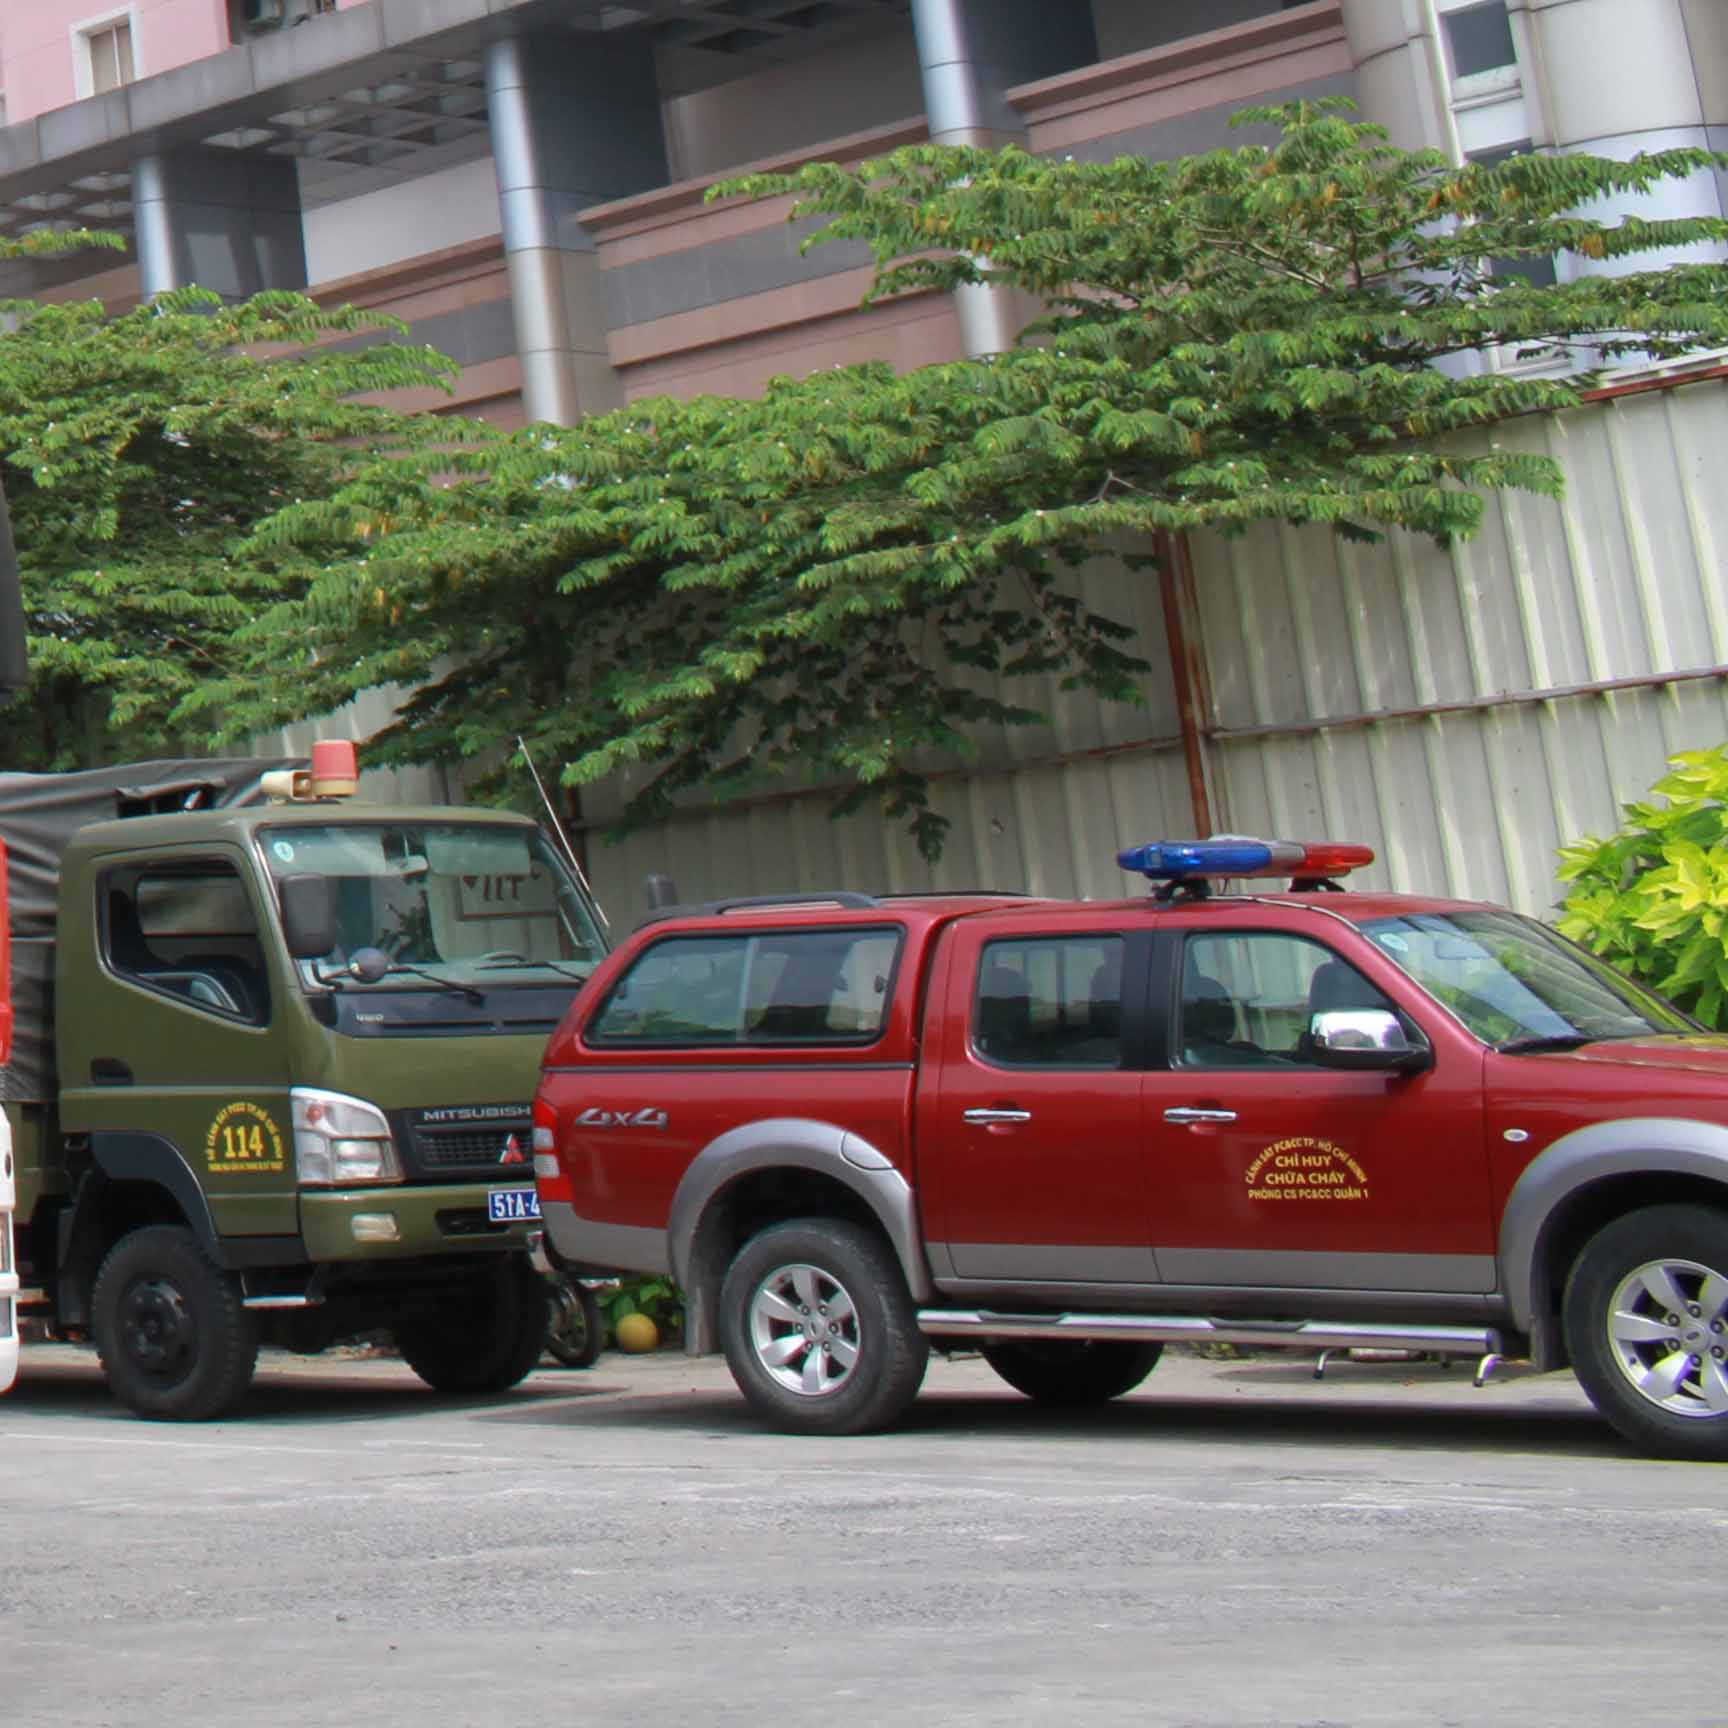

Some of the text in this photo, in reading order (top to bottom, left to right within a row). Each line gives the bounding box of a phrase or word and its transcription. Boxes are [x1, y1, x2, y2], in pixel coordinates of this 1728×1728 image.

[223, 1125, 264, 1158] 114
[1275, 1152, 1332, 1168] CHỈ HUY
[1265, 1170, 1346, 1185] CHỮA CHÁY
